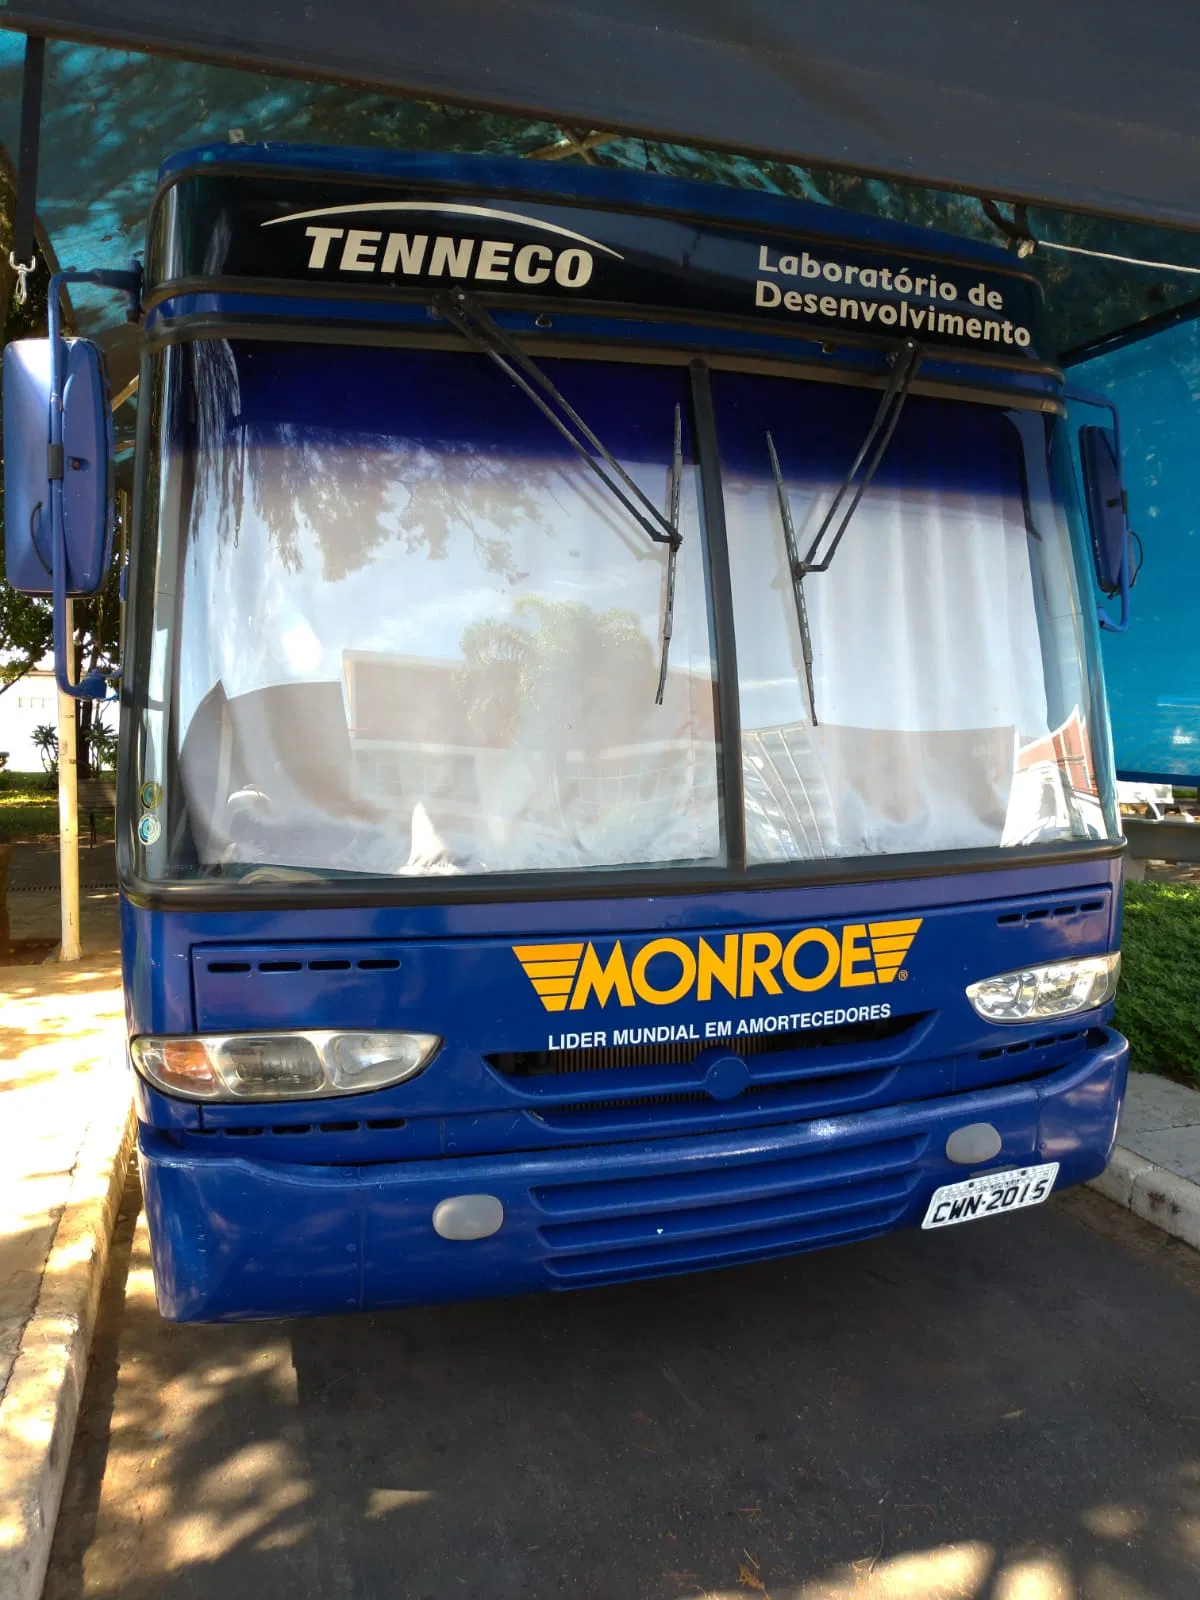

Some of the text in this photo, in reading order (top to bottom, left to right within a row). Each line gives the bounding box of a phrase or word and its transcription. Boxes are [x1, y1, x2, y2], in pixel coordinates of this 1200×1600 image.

[305, 226, 593, 288] TENNECO
[758, 246, 1003, 310] Laboratório de
[755, 280, 1031, 347] Desenvolvimento
[569, 924, 877, 1011] MONROE
[548, 1003, 891, 1051] LIDER MUNDIAL EM AMORTECEDORES
